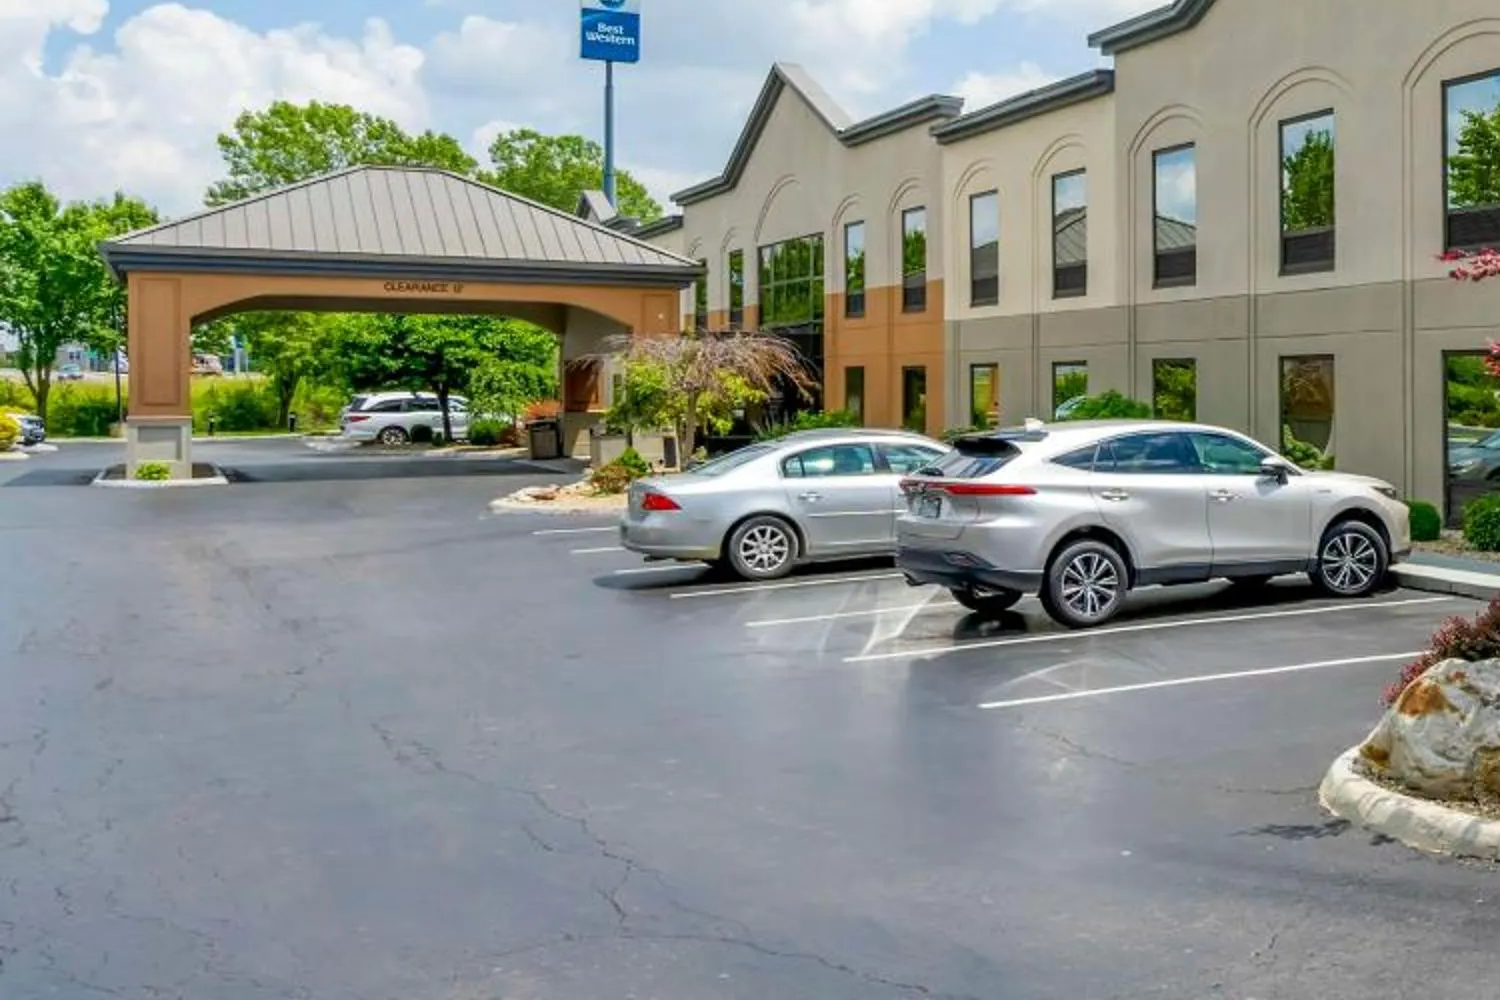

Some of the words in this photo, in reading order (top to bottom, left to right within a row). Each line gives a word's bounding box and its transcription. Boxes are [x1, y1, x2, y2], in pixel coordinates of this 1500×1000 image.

[597, 22, 624, 34] Best
[585, 31, 635, 46] Western
[383, 281, 449, 293] CLEARANCE
